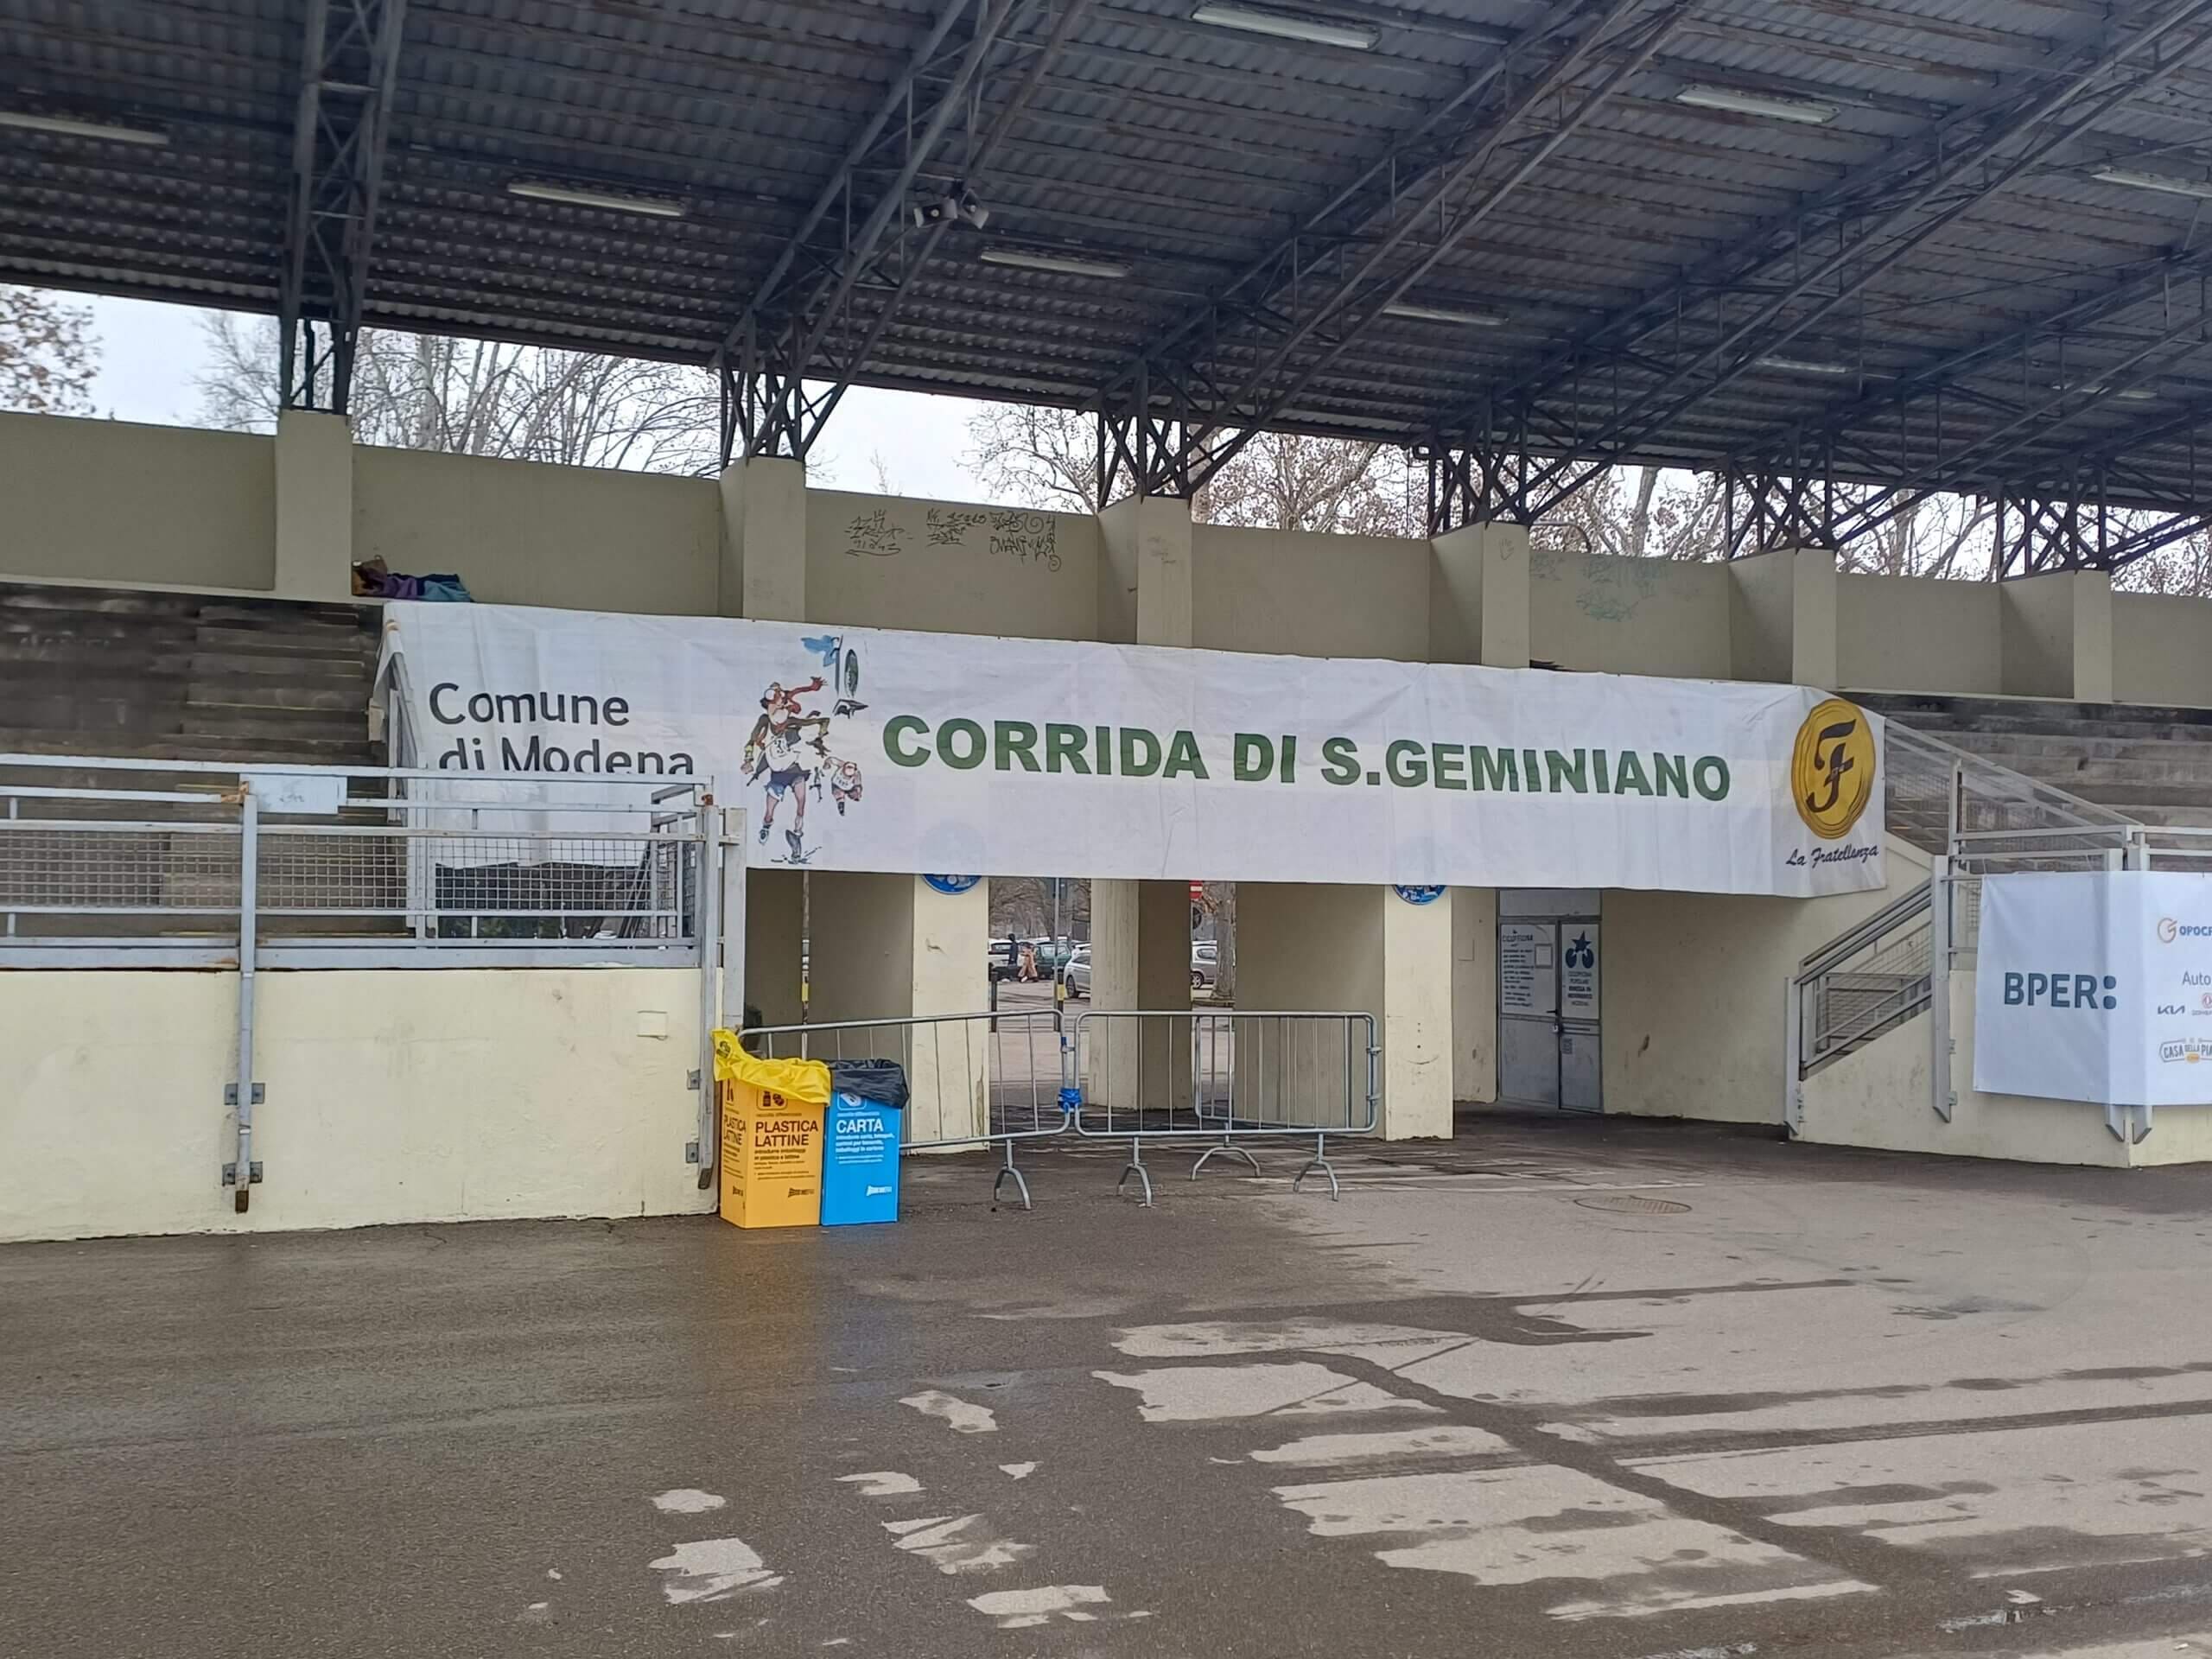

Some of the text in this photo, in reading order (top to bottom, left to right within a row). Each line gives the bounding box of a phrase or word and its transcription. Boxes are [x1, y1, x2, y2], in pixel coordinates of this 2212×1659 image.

[429, 683, 630, 726] Comune
[438, 734, 694, 776] di Modena
[882, 715, 1731, 802] CORRIDA DI S.GEMINIANO
[1785, 848, 1807, 866] La
[2182, 970, 2211, 986] Auto
[2164, 1045, 2184, 1058] CASA
[755, 1120, 819, 1134] PLASTICA
[836, 1118, 884, 1134] CARTA
[754, 1134, 810, 1147] LATTINE
